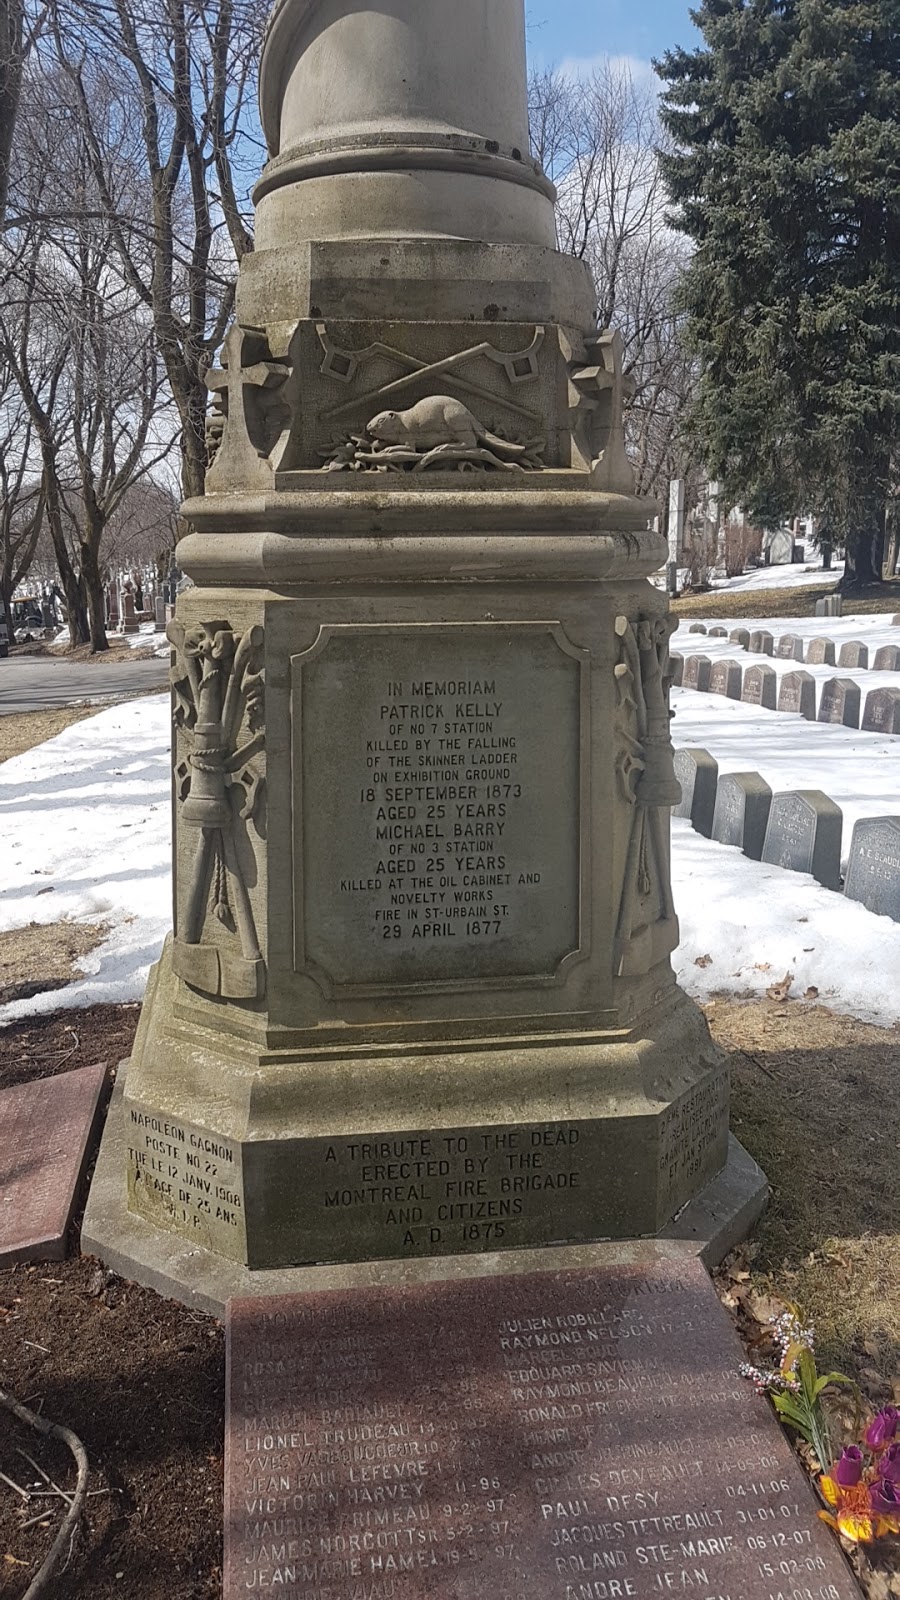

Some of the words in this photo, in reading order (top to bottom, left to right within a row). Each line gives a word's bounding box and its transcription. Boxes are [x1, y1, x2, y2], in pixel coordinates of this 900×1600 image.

[388, 682, 402, 696] IN
[412, 681, 496, 696] MEMORIAM
[380, 704, 444, 719] PATRICK
[456, 703, 502, 718] KELLY
[389, 724, 404, 735] OF
[410, 724, 424, 734] NO
[431, 724, 438, 734] 7
[444, 722, 492, 734] STATION
[366, 740, 408, 751] KILLED
[416, 739, 430, 750] BY
[438, 738, 461, 750] THE
[468, 737, 516, 748] FALLING
[366, 756, 380, 768] OF
[388, 756, 411, 767] THE
[418, 754, 465, 766] SKINNER
[472, 753, 518, 764] LADDER
[374, 772, 388, 783] ON
[394, 770, 459, 782] EXHIBITION
[466, 768, 510, 780] GROUND
[360, 789, 375, 802] 18
[386, 786, 476, 801] SEPTEMBER
[486, 784, 522, 798] 1873
[376, 806, 416, 820] AGED
[427, 805, 446, 818] 25
[456, 803, 506, 818] YEARS
[376, 824, 444, 840] MICHAEL
[454, 822, 505, 836] BARRY
[389, 844, 404, 854] OF
[410, 843, 424, 853] NO
[432, 842, 438, 853] 3
[446, 840, 493, 852] STATION
[376, 860, 416, 874] AGED
[426, 858, 445, 872] 25
[455, 856, 506, 870] YEARS
[340, 879, 382, 891] KILLED
[389, 878, 403, 889] AT
[411, 877, 434, 888] THE
[440, 876, 458, 887] OIL
[463, 874, 511, 886] CABINET
[518, 873, 540, 884] AND
[391, 892, 445, 905] NOVELTY
[454, 890, 493, 901] WORKS
[375, 910, 400, 921] FIRE
[408, 908, 418, 919] IN
[425, 906, 486, 918] ST-URBAIN
[493, 905, 509, 916] ST.
[383, 925, 401, 938] 29
[412, 923, 456, 938] APRIL
[466, 921, 501, 935] 1877
[146, 1136, 180, 1160] POSTE
[186, 1152, 200, 1168] NO
[205, 1161, 218, 1176] 22
[190, 1134, 232, 1162] GAGNON
[325, 1147, 337, 1162] A
[347, 1140, 431, 1160] TRIBUTE
[443, 1137, 468, 1154] TO
[482, 1133, 519, 1150] THE
[531, 1129, 580, 1146] DEAD
[362, 1160, 450, 1182] ERECTED
[464, 1157, 488, 1174] BY
[506, 1153, 543, 1170] THE
[670, 1160, 678, 1178] ET
[152, 1158, 164, 1173] LE
[168, 1165, 178, 1179] 12
[182, 1172, 212, 1196] JANV.
[216, 1186, 240, 1207] 1908
[324, 1184, 431, 1208] MONTREAL
[446, 1180, 488, 1198] FIRE
[501, 1172, 580, 1193] BRIGADE
[179, 1189, 192, 1205] DE
[198, 1198, 210, 1214] 25
[216, 1207, 237, 1226] ANS
[386, 1207, 422, 1225] AND
[438, 1198, 523, 1222] CITIZENS
[404, 1231, 420, 1246] A.
[463, 1222, 505, 1240] 1875
[498, 1316, 552, 1334] JULIEN
[556, 1308, 644, 1328] ROBILLARD
[501, 1331, 582, 1350] RAYMOND
[587, 1323, 654, 1341] NELSON
[513, 1383, 592, 1402] RAYMOND
[519, 1404, 583, 1422] RONALD
[245, 1432, 313, 1452] LIONEL
[321, 1421, 410, 1445] TRUDEAU
[244, 1453, 290, 1477] YVES
[246, 1476, 290, 1494] JEAN
[350, 1460, 428, 1482] LEFEVRE
[245, 1491, 339, 1516] VICTORIN
[348, 1482, 424, 1504] HARVEY
[541, 1500, 596, 1520] PAUL
[606, 1492, 660, 1512] DESY
[726, 1480, 790, 1498] 04-11-06
[552, 1522, 626, 1546] JACQUES
[627, 1510, 724, 1537] TETREAULT
[736, 1504, 800, 1524] 31-01-07
[245, 1540, 313, 1564] JAMES
[320, 1528, 416, 1554] NORCOTT
[555, 1550, 628, 1575] ROLAND
[635, 1536, 734, 1564] STE-MARIE
[746, 1530, 812, 1550] 06-12-07
[246, 1566, 296, 1588] JEAN
[370, 1550, 438, 1574] HAMEL
[564, 1578, 638, 1600] ANDRE
[653, 1568, 710, 1592] JEAN
